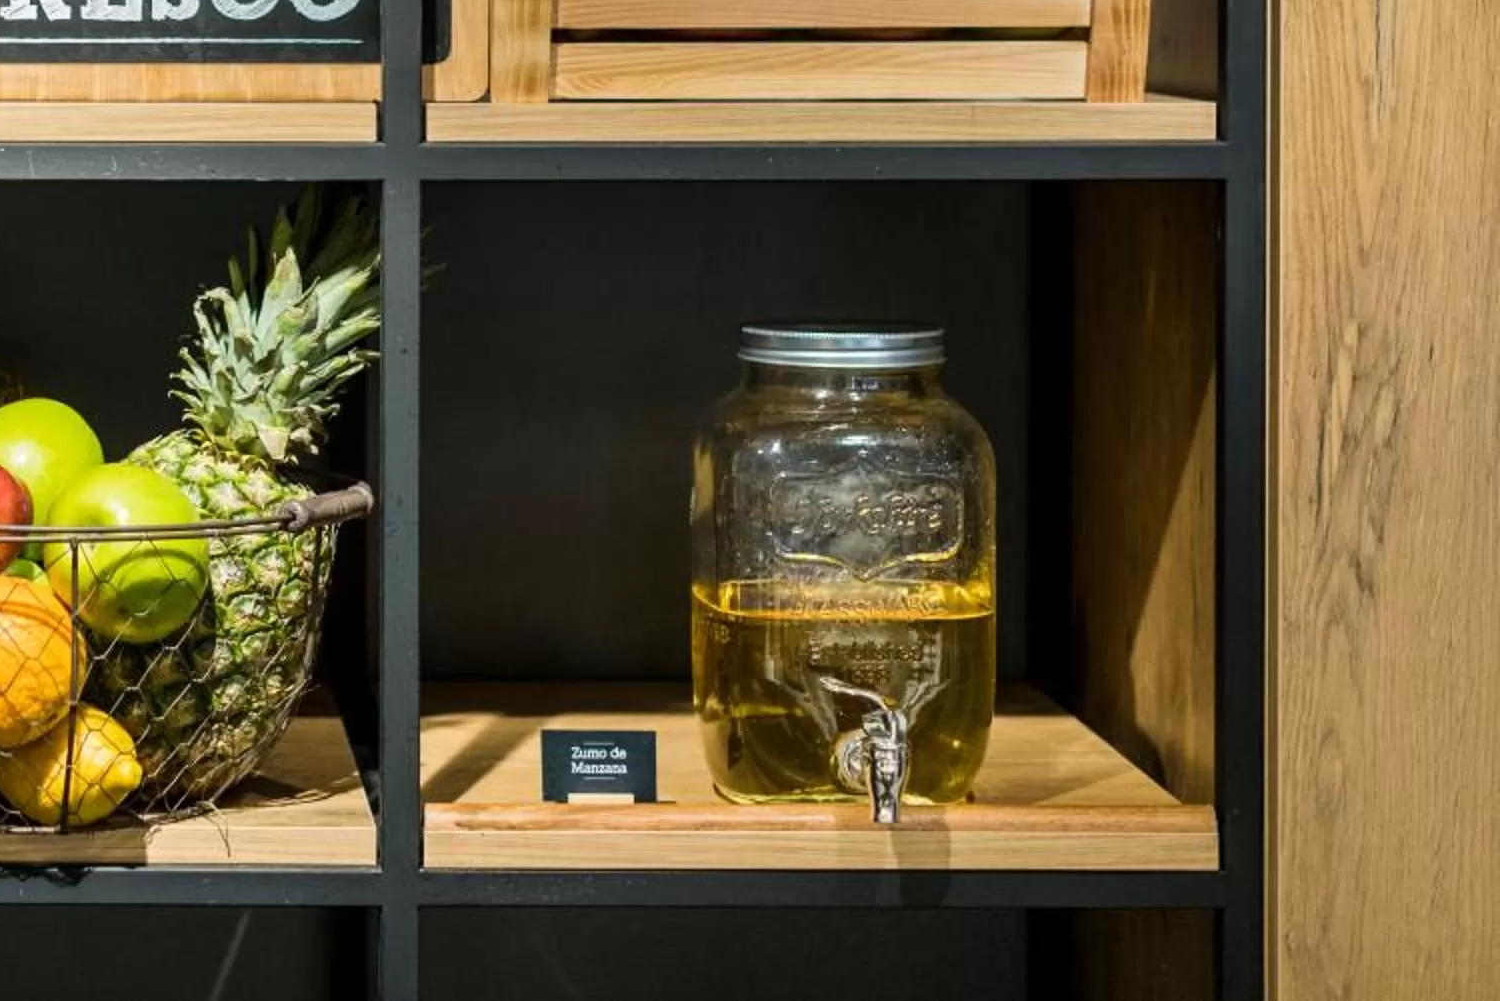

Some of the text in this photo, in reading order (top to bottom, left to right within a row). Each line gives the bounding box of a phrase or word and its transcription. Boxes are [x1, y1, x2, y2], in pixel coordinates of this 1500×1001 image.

[571, 747, 627, 759] Zumo de
[571, 762, 627, 774] Manzana
